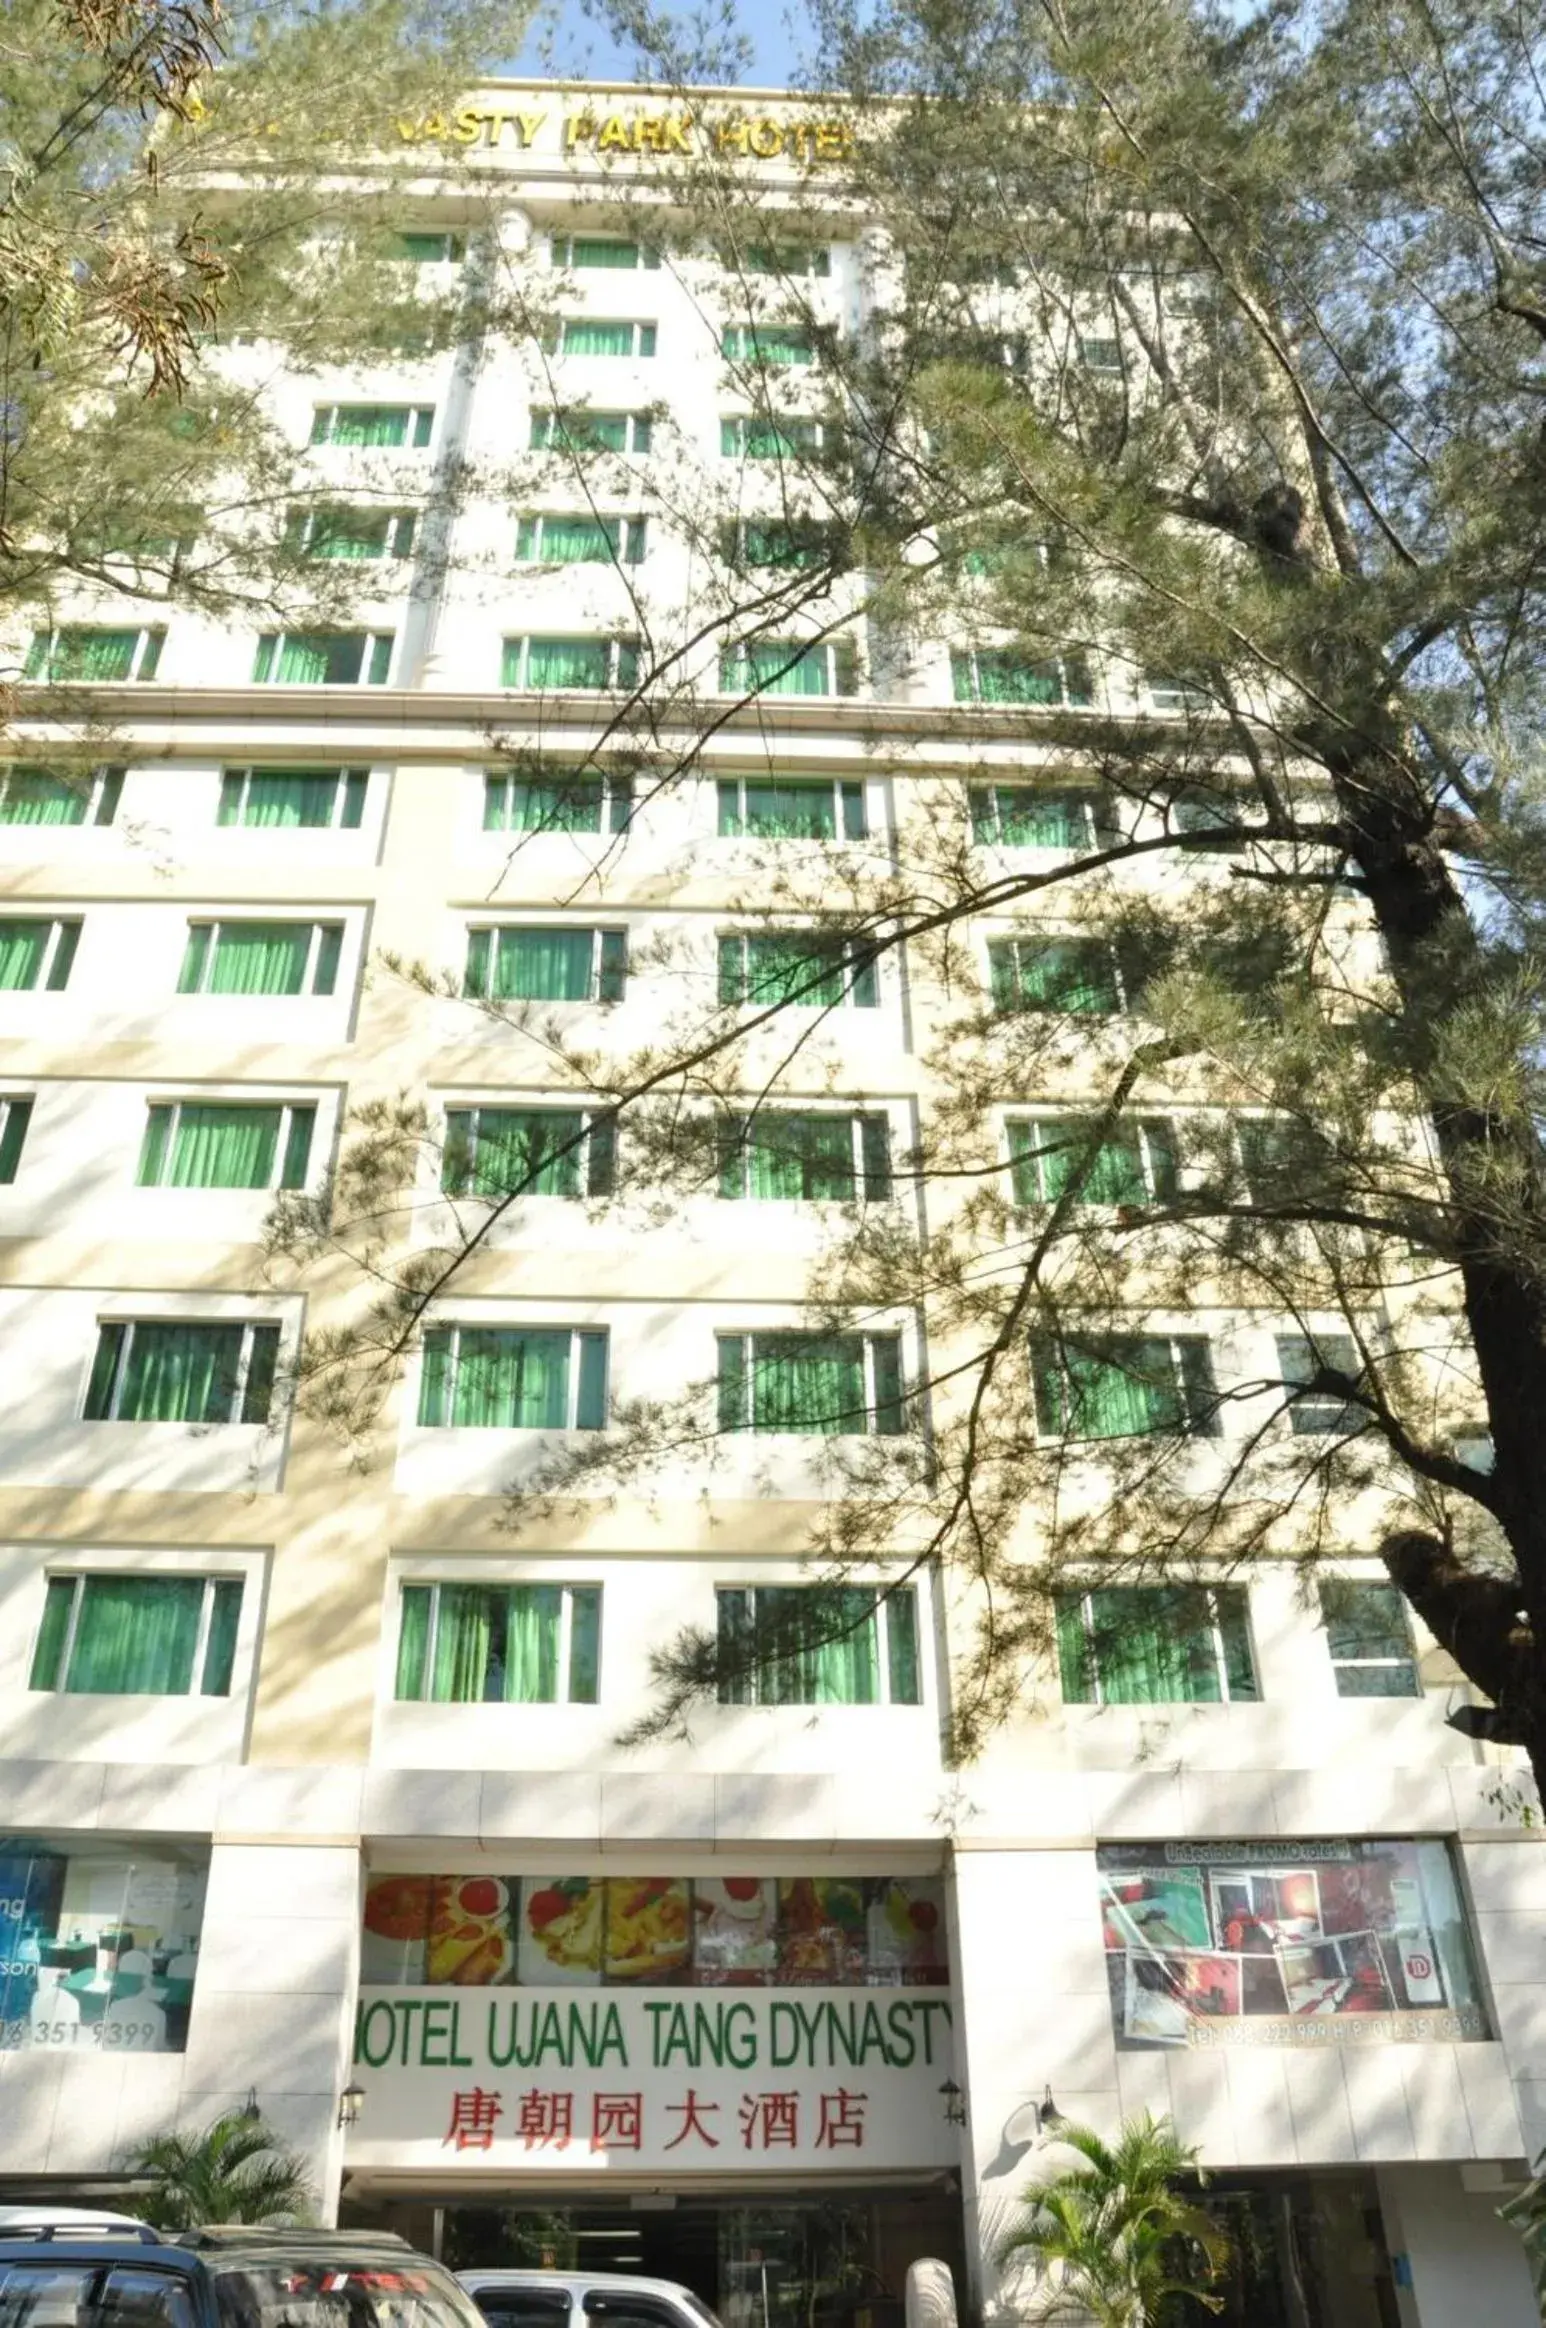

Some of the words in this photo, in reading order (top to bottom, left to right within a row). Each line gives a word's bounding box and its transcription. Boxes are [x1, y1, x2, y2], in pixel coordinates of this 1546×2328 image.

[566, 112, 692, 154] PARK
[35, 2022, 79, 2044] 351
[487, 2001, 628, 2067] UJANA
[643, 2001, 757, 2069] TANG
[441, 2085, 867, 2153] 唐朝园大酒店
